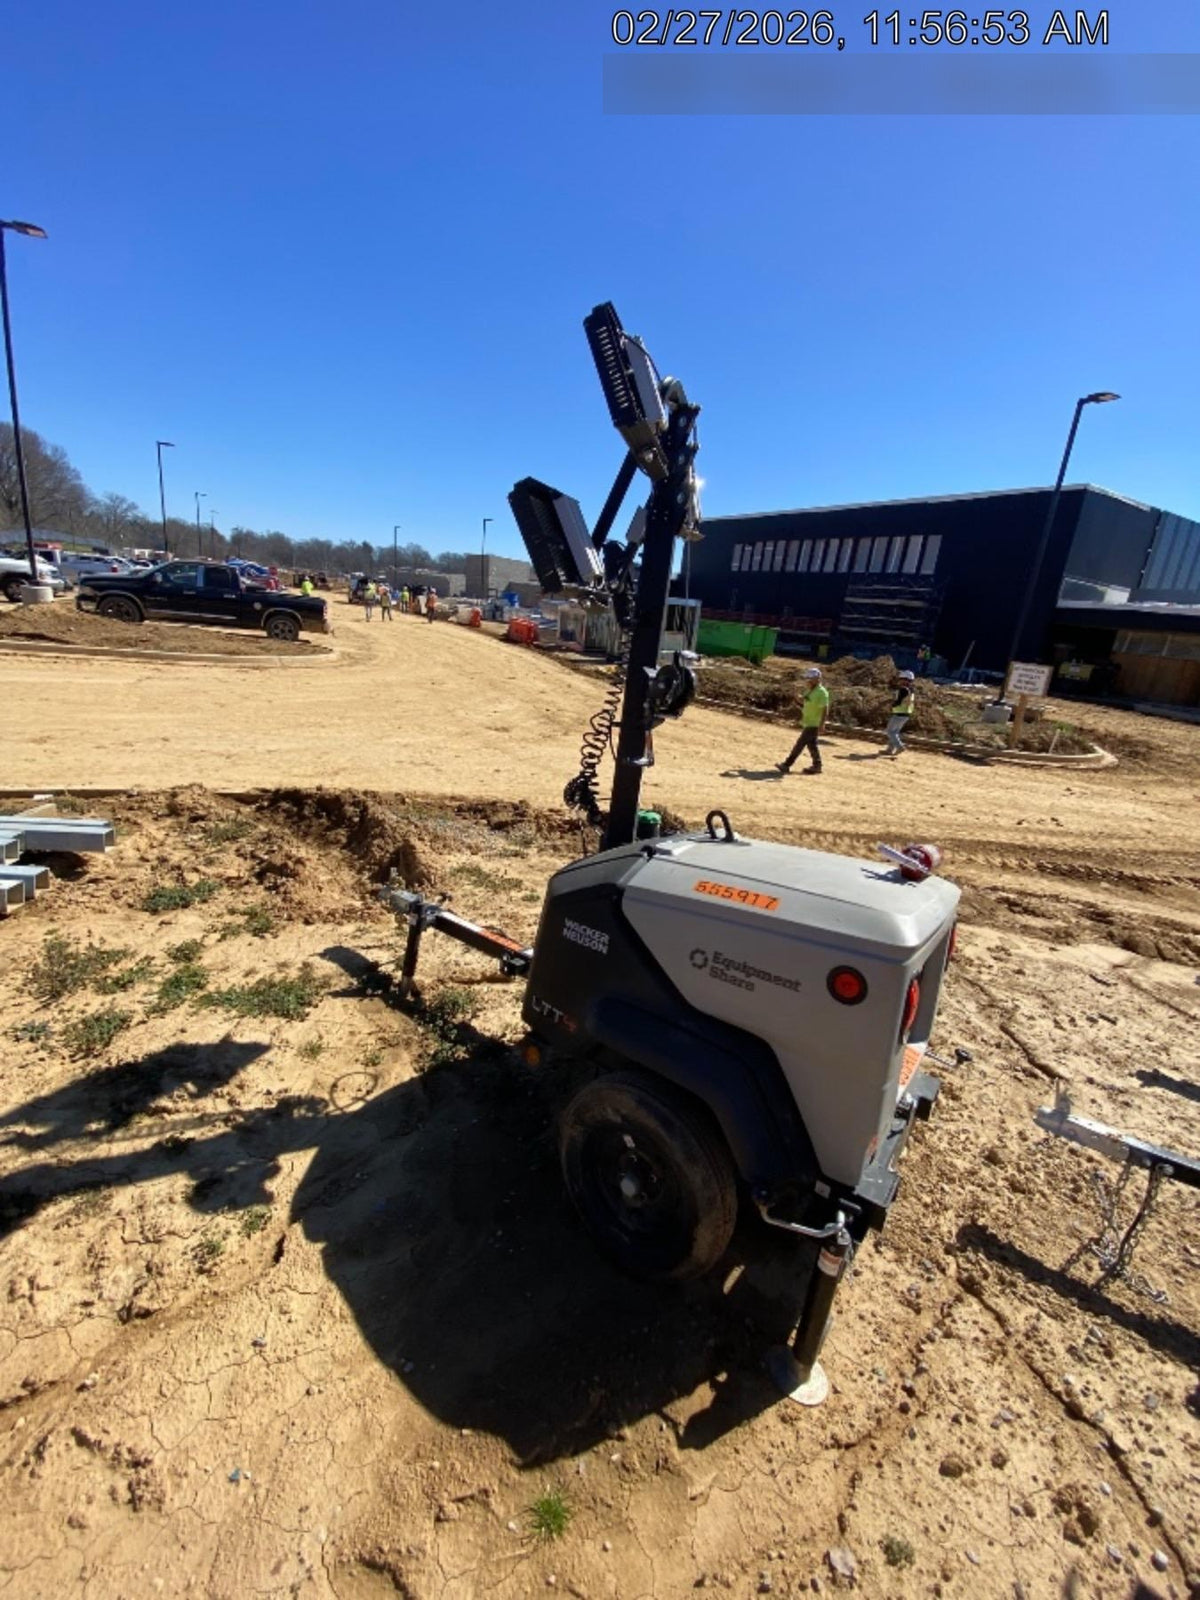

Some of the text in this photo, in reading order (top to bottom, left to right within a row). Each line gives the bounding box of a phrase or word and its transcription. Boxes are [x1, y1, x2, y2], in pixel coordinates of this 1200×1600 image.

[562, 927, 609, 955] NEUSON
[564, 917, 610, 945] WACKER
[708, 965, 755, 992] Share
[711, 950, 802, 992] Equipment
